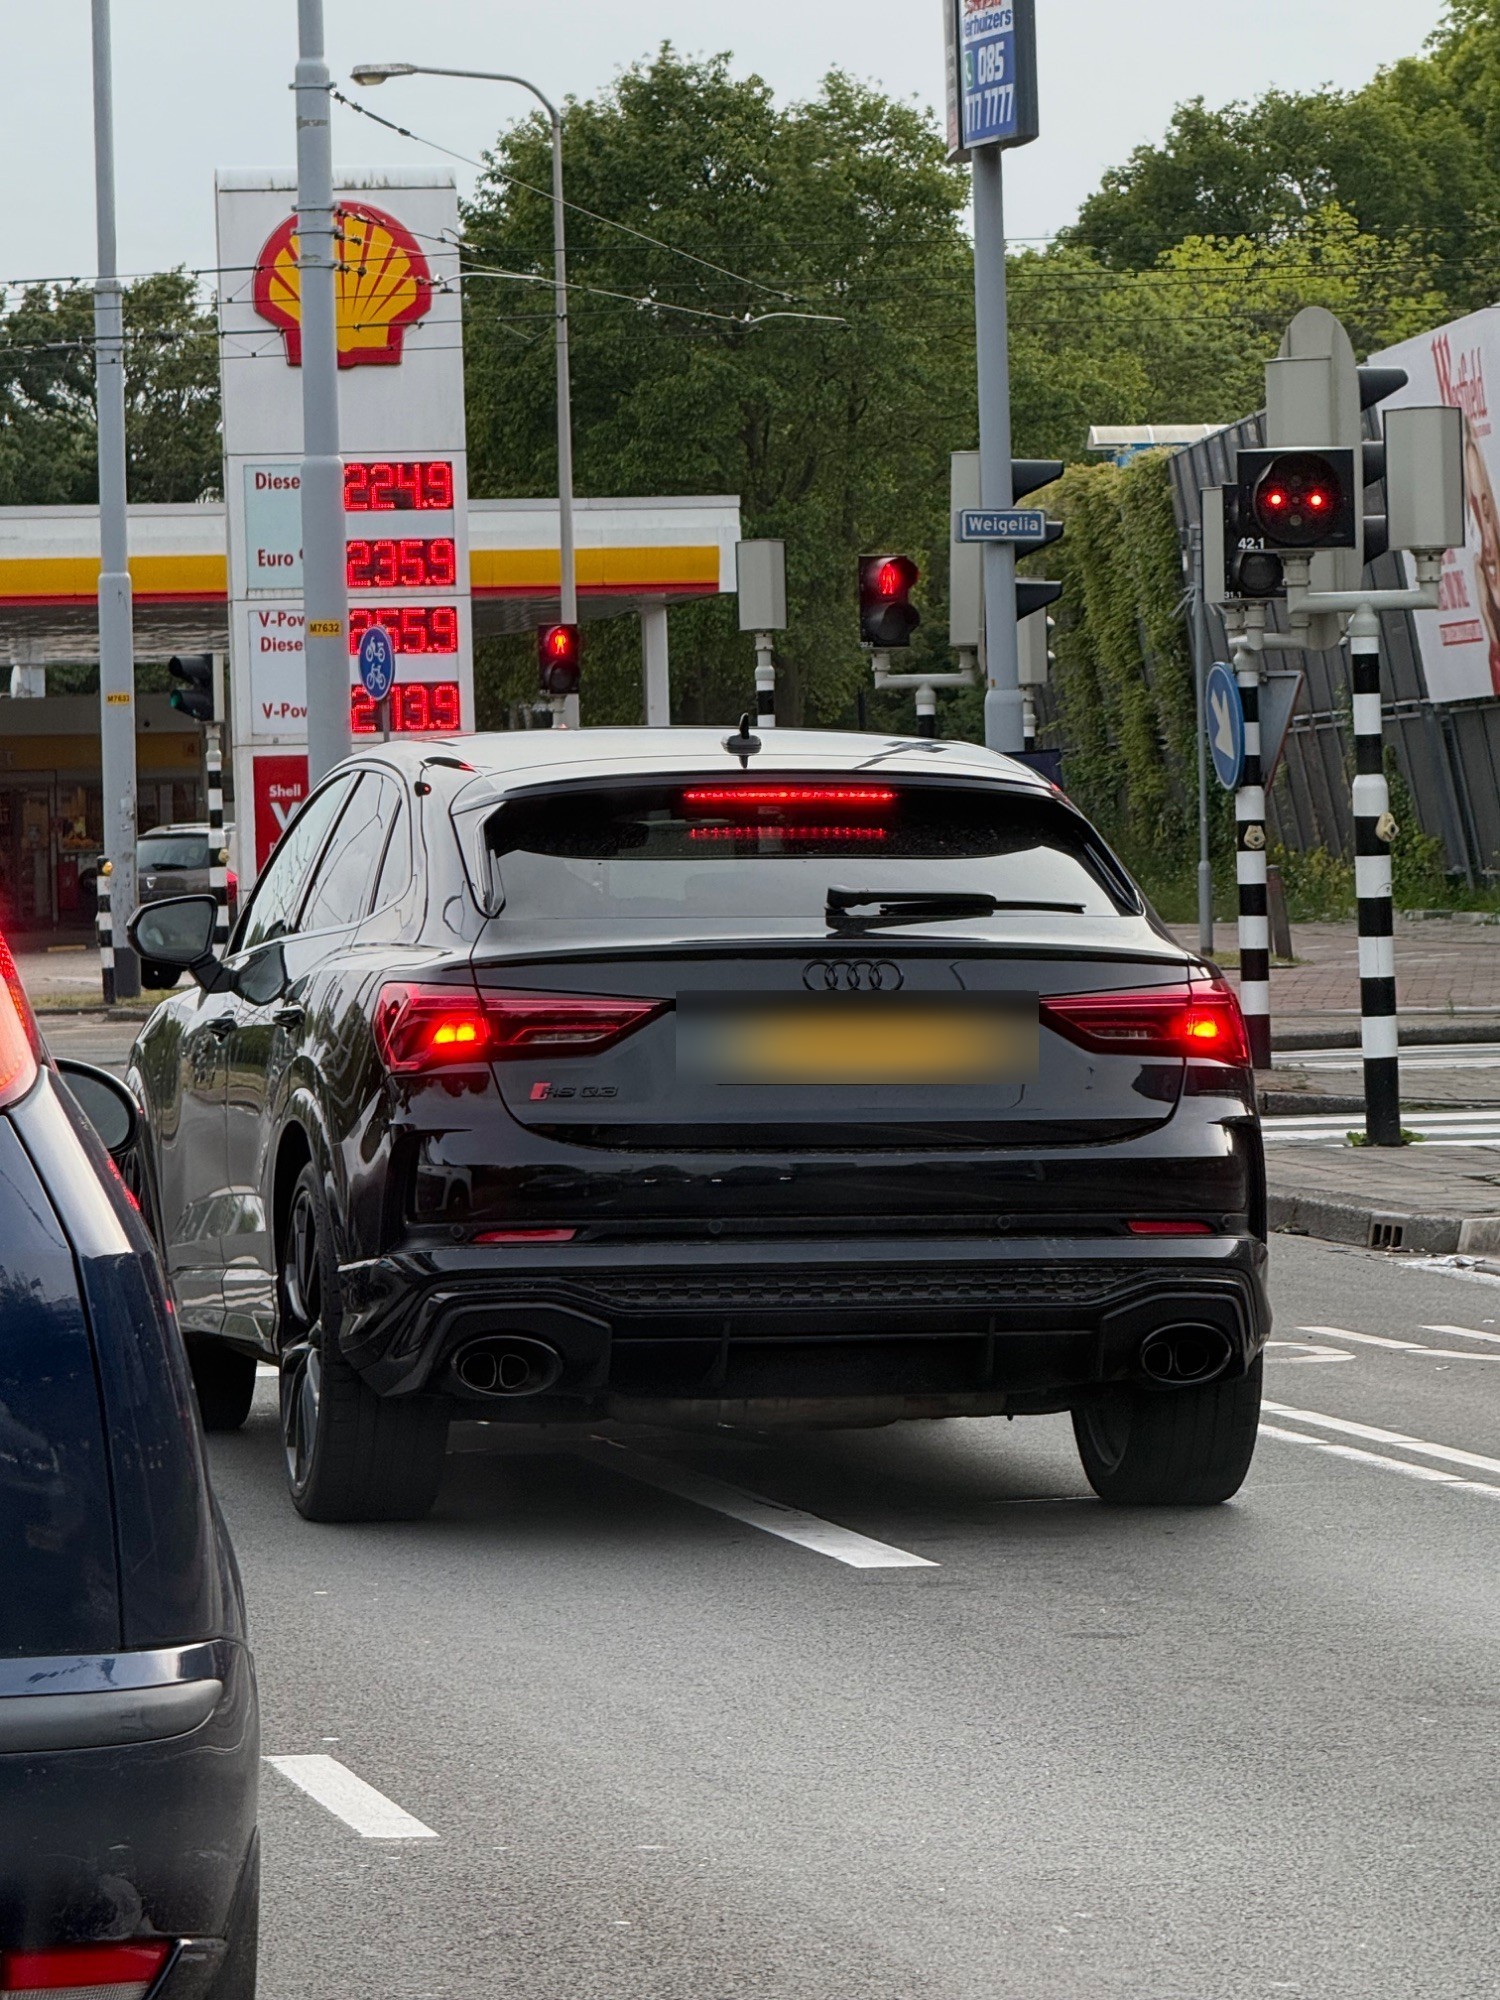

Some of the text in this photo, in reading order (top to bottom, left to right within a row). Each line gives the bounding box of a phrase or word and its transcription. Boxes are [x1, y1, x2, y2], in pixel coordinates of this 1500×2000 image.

[978, 41, 1005, 85] 085
[984, 83, 1014, 128] 7777
[968, 516, 1039, 535] Weigelia
[1238, 537, 1265, 550] 42.1
[257, 548, 295, 567] Euro
[309, 623, 341, 633] M7632
[268, 783, 302, 798] Shell
[580, 1086, 619, 1099] Q3
